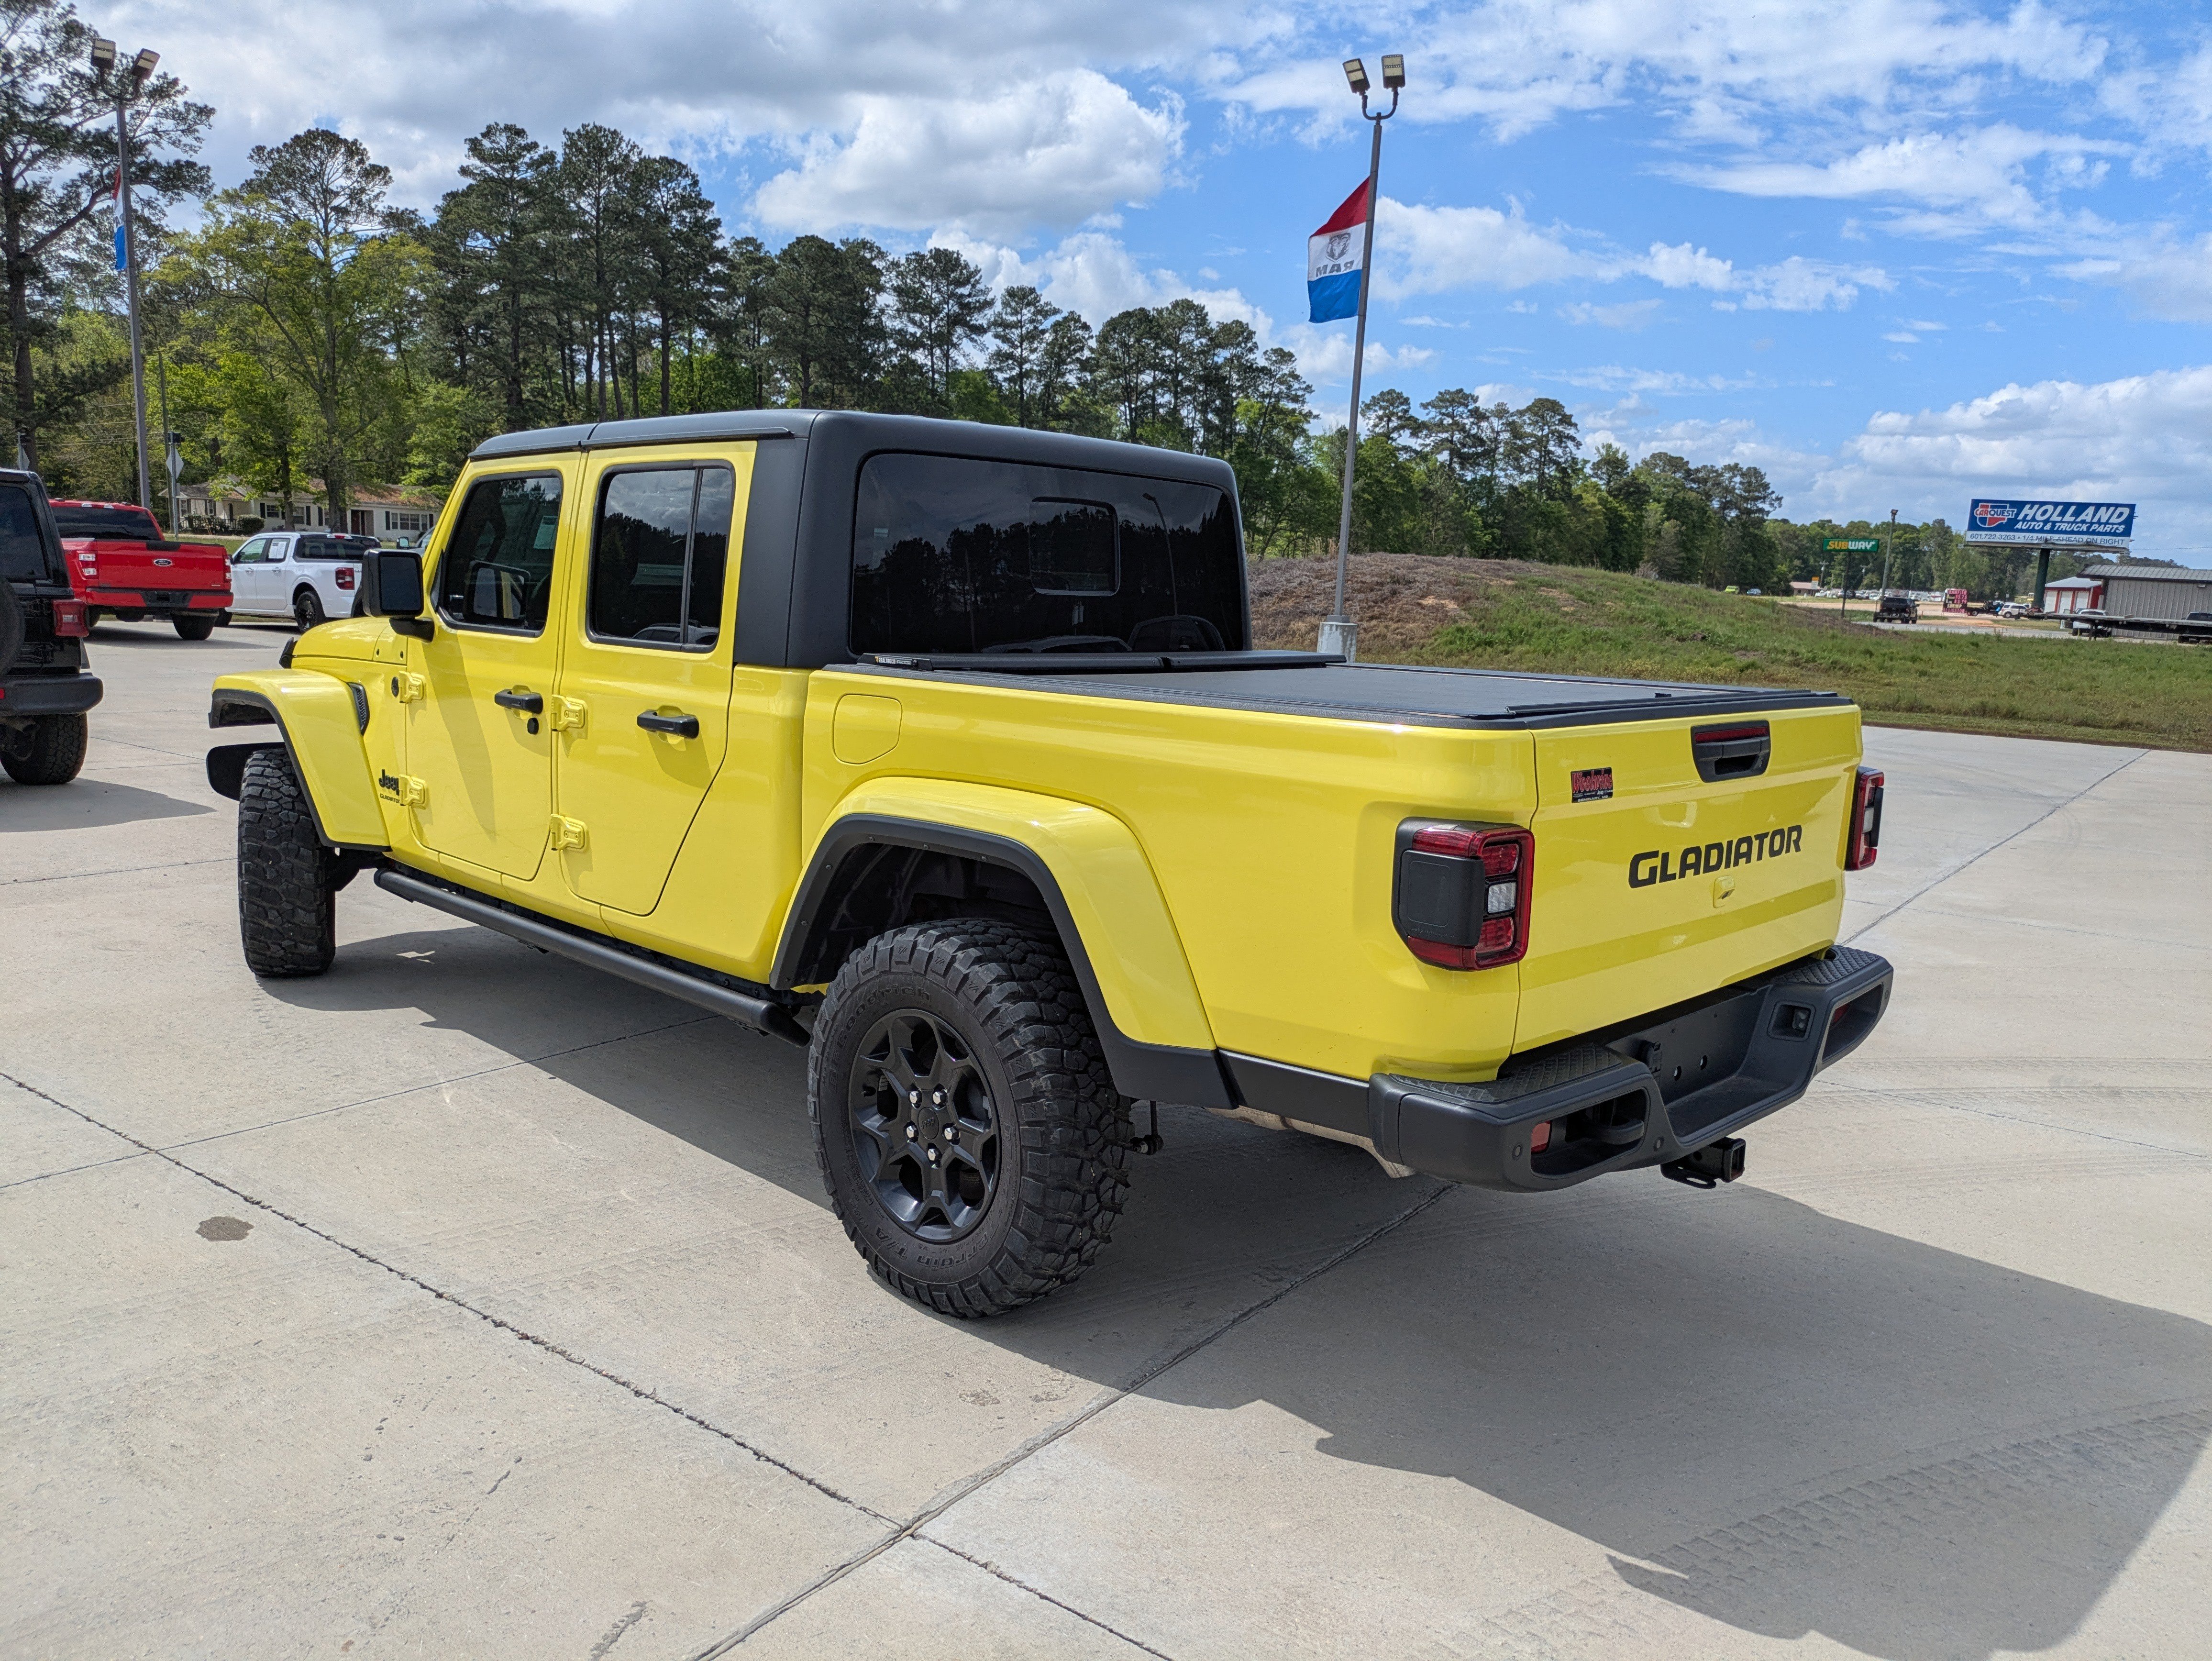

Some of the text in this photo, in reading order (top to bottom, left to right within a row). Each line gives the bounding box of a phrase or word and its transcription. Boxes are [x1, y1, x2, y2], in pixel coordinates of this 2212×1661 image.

[2017, 504, 2130, 523] HOLLAND
[2014, 521, 2125, 533] AUTO & TRUCK PARTS
[1827, 541, 1876, 550] SUBWAY
[1628, 824, 1802, 889] GLADIATOR
